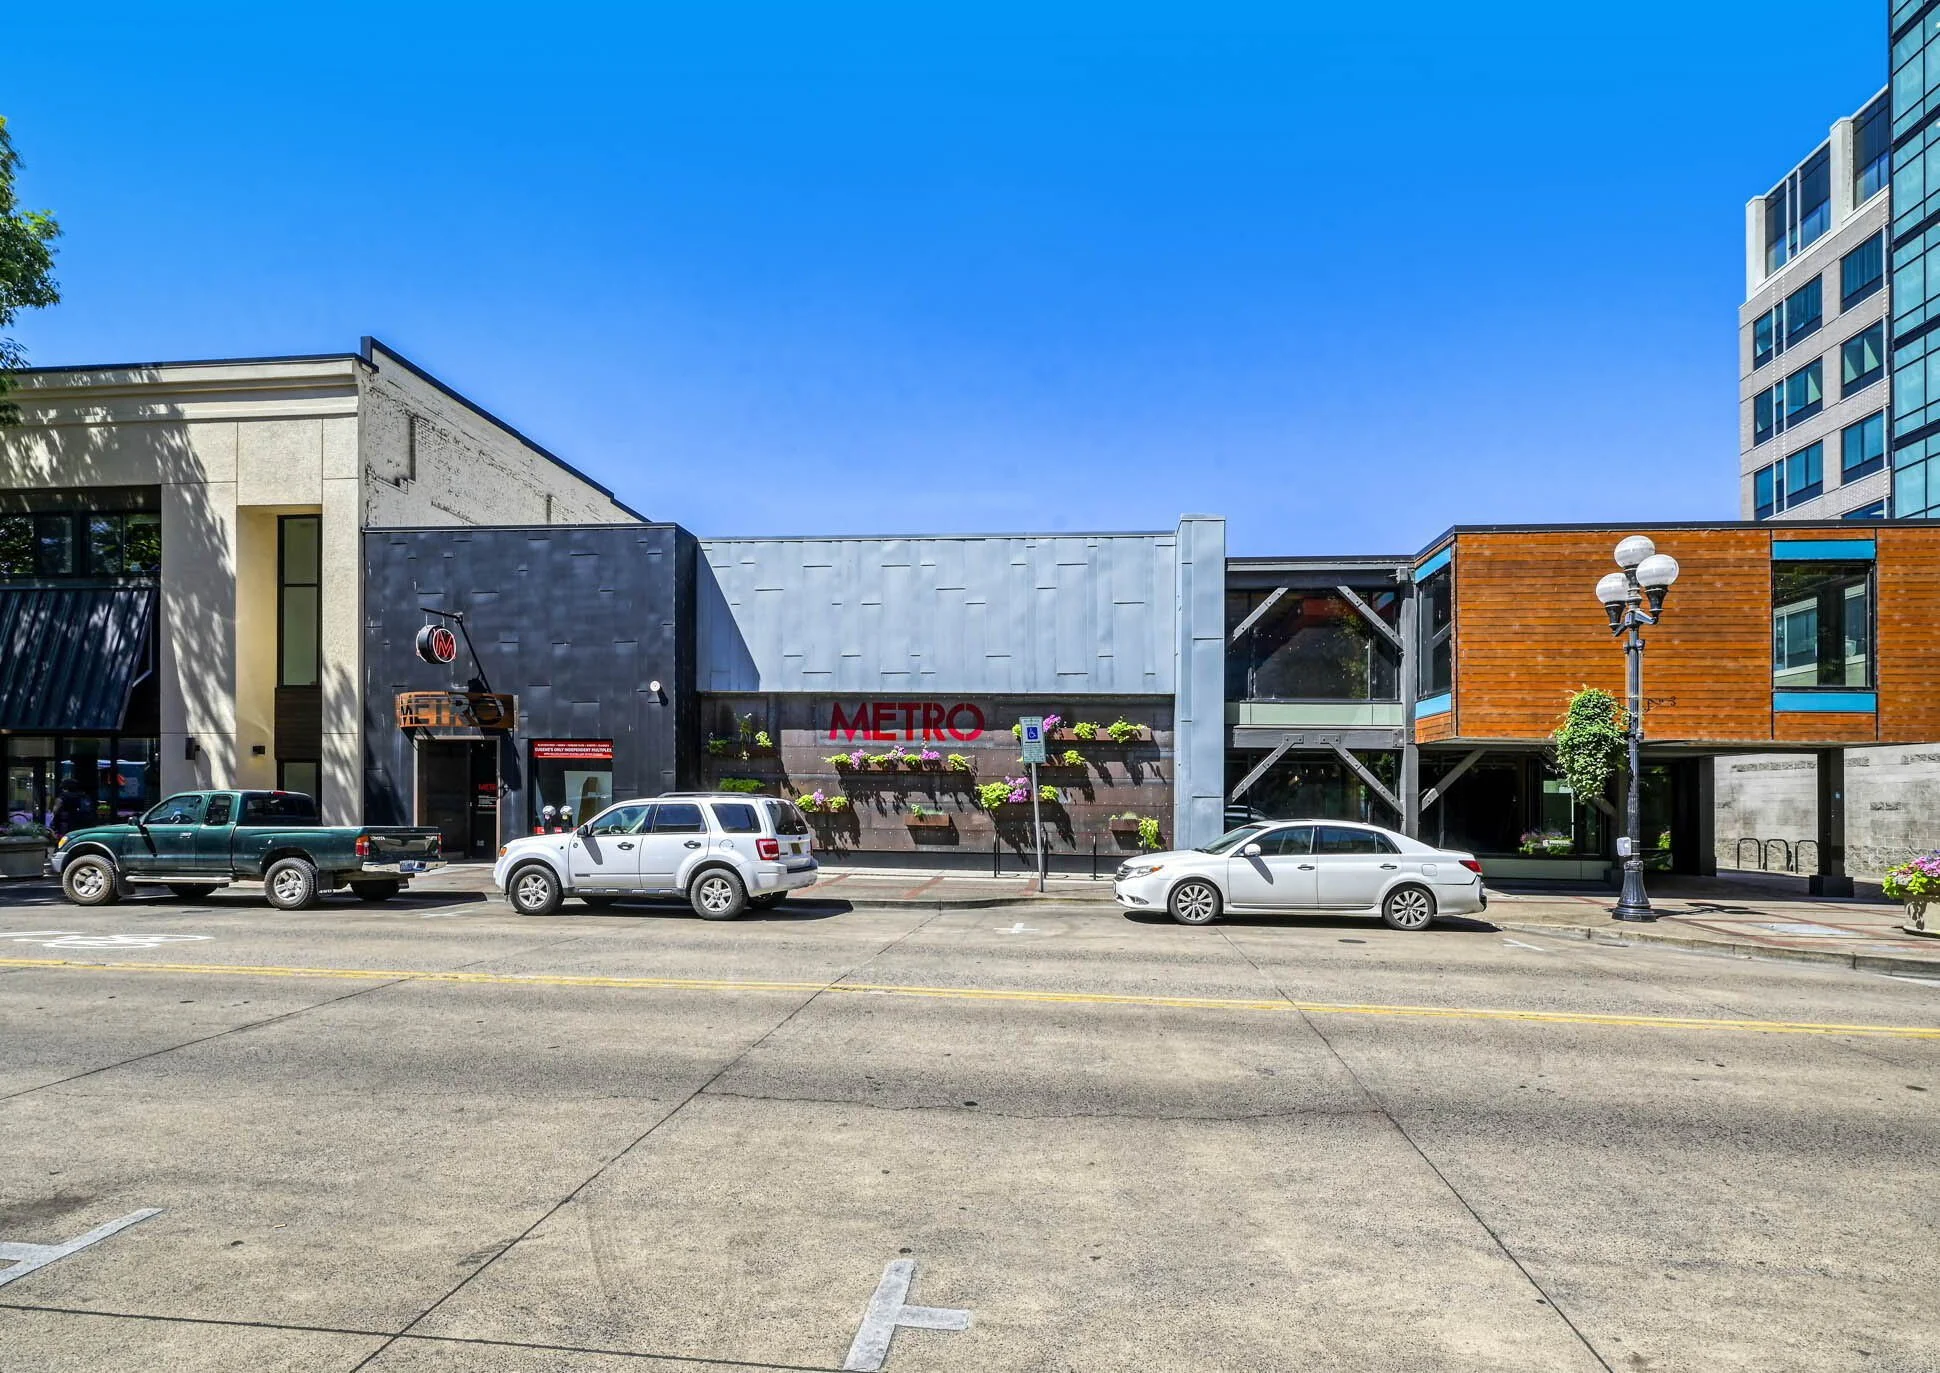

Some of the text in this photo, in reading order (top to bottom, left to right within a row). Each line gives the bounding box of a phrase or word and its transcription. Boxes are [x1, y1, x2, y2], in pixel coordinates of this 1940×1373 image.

[435, 631, 454, 657] M
[400, 693, 505, 726] METRO
[829, 702, 985, 742] METRO
